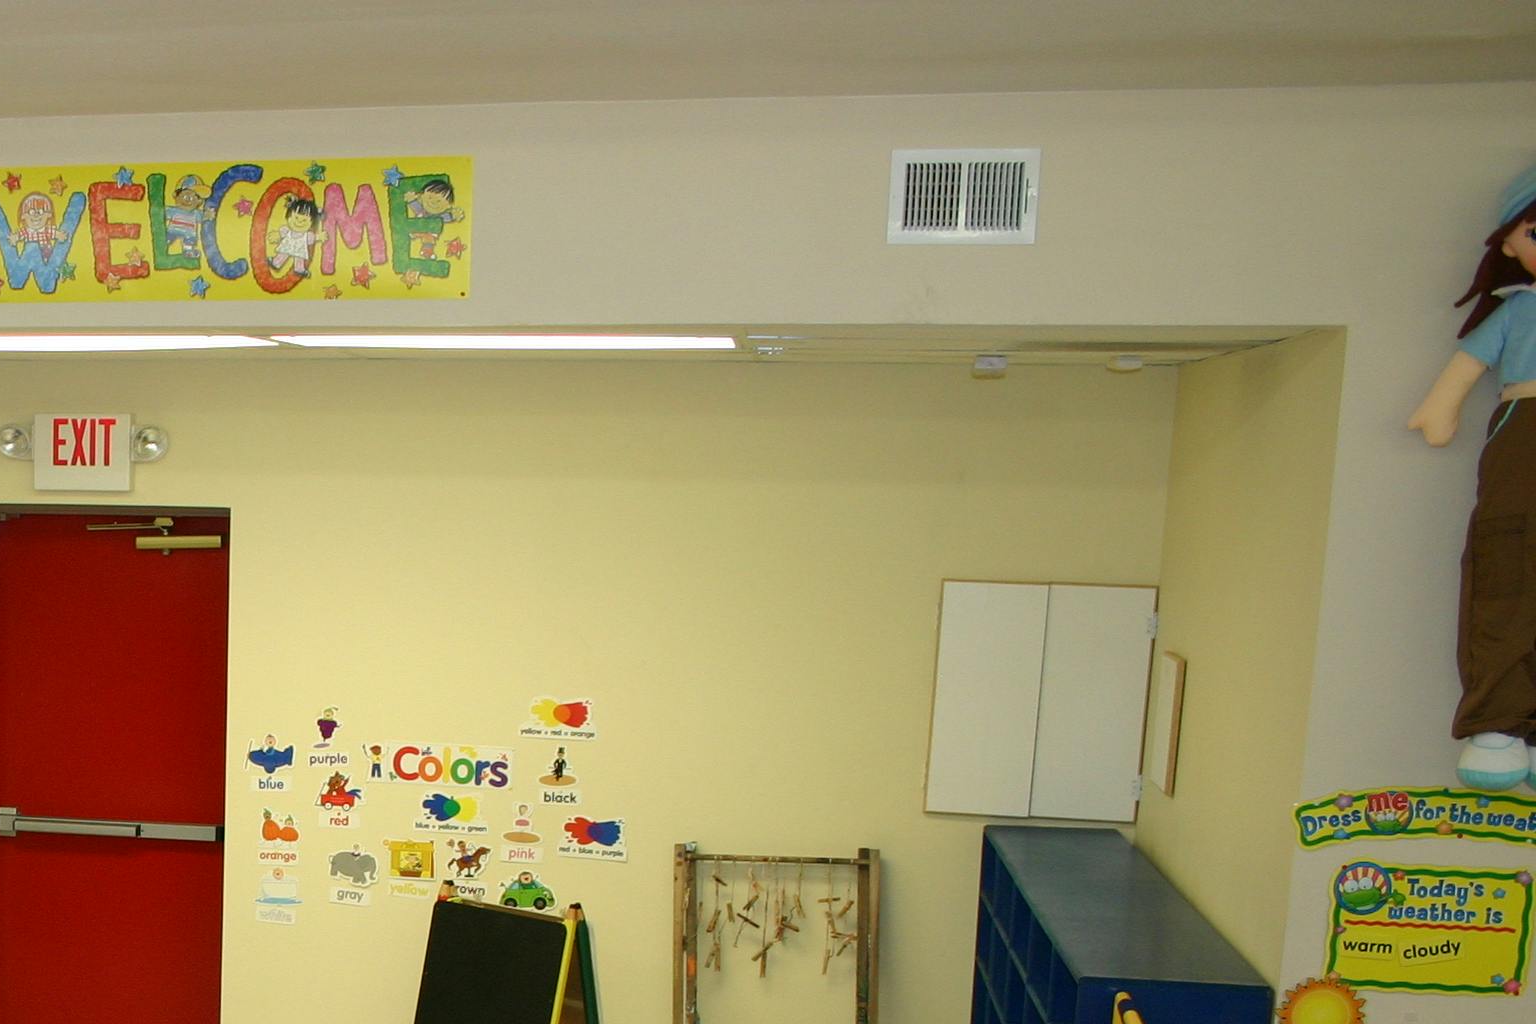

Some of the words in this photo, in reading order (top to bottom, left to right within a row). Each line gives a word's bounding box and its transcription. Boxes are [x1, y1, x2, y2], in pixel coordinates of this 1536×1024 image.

[52, 418, 116, 467] EXIT
[309, 753, 348, 766] purple
[393, 746, 508, 787] Colors
[258, 779, 284, 790] blue
[544, 792, 577, 803] black
[329, 815, 349, 826] red
[1300, 808, 1362, 836] Dress
[1367, 792, 1409, 813] me
[1413, 799, 1446, 820] for
[1449, 803, 1484, 821] the
[259, 852, 297, 862] orange
[509, 847, 535, 860] pink
[337, 890, 364, 902] gray
[456, 886, 485, 896] own
[1407, 878, 1485, 906] Today's
[1387, 903, 1477, 924] weather
[1486, 907, 1503, 924] is
[1342, 940, 1393, 954] warm
[1402, 939, 1462, 960] cloudy
